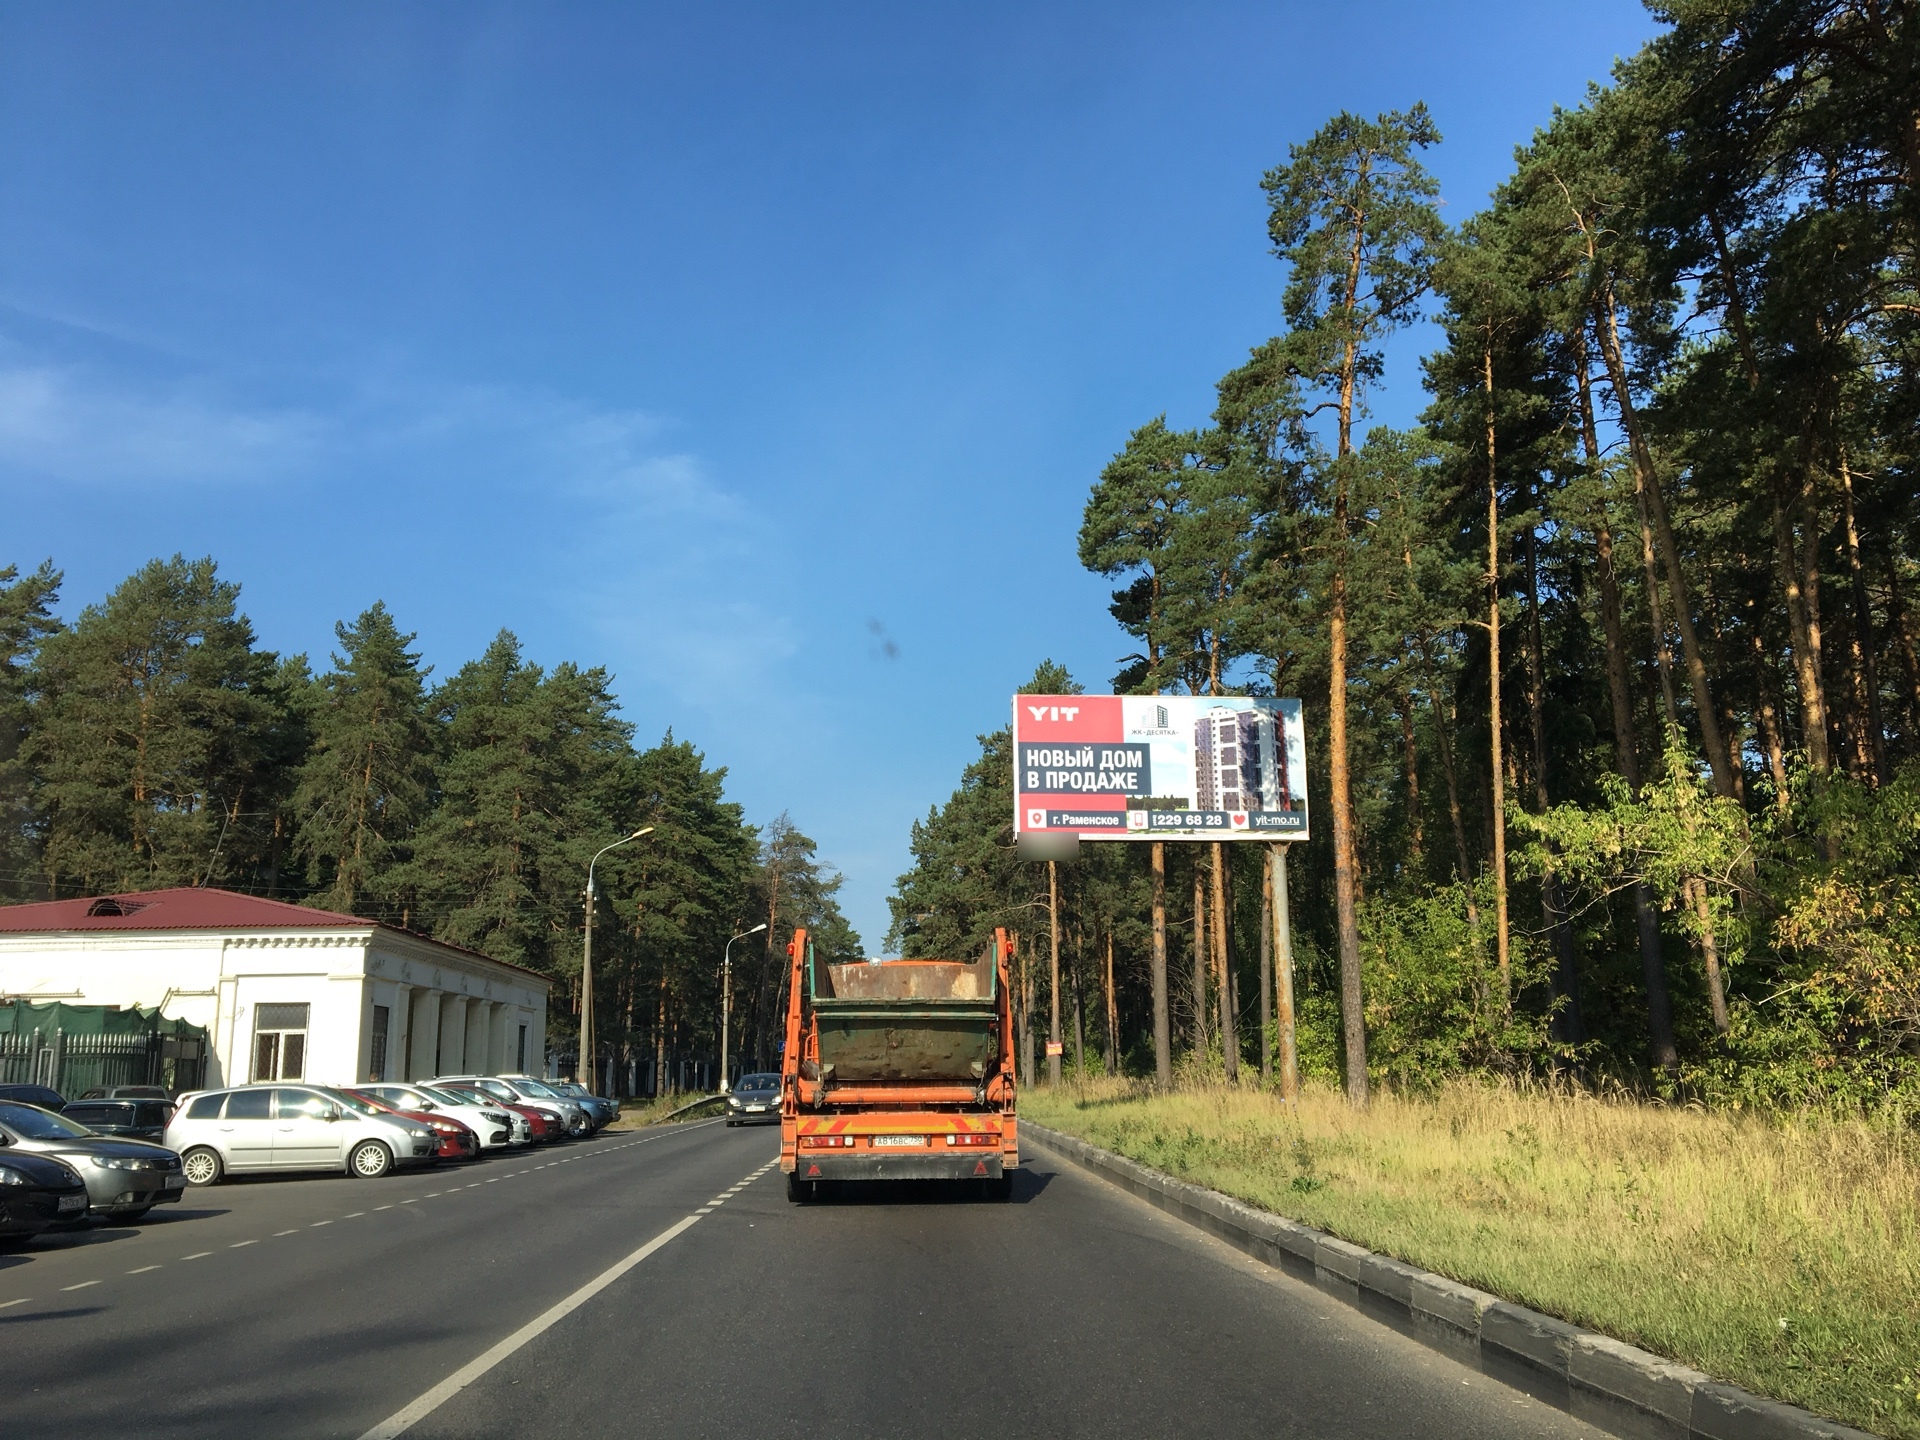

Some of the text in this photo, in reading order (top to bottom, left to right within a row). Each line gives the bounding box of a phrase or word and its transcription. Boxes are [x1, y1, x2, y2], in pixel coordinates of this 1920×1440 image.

[1027, 706, 1080, 722] YIT
[1026, 746, 1143, 770] НОВЫЙ ДОМ
[1027, 771, 1138, 792] В ПРОДАЖЕ
[1052, 814, 1119, 826] г. Раменское
[1157, 814, 1182, 826] 229
[1185, 814, 1202, 826] 68
[1205, 814, 1223, 826] 28
[1255, 815, 1300, 826] yit-mo.ru
